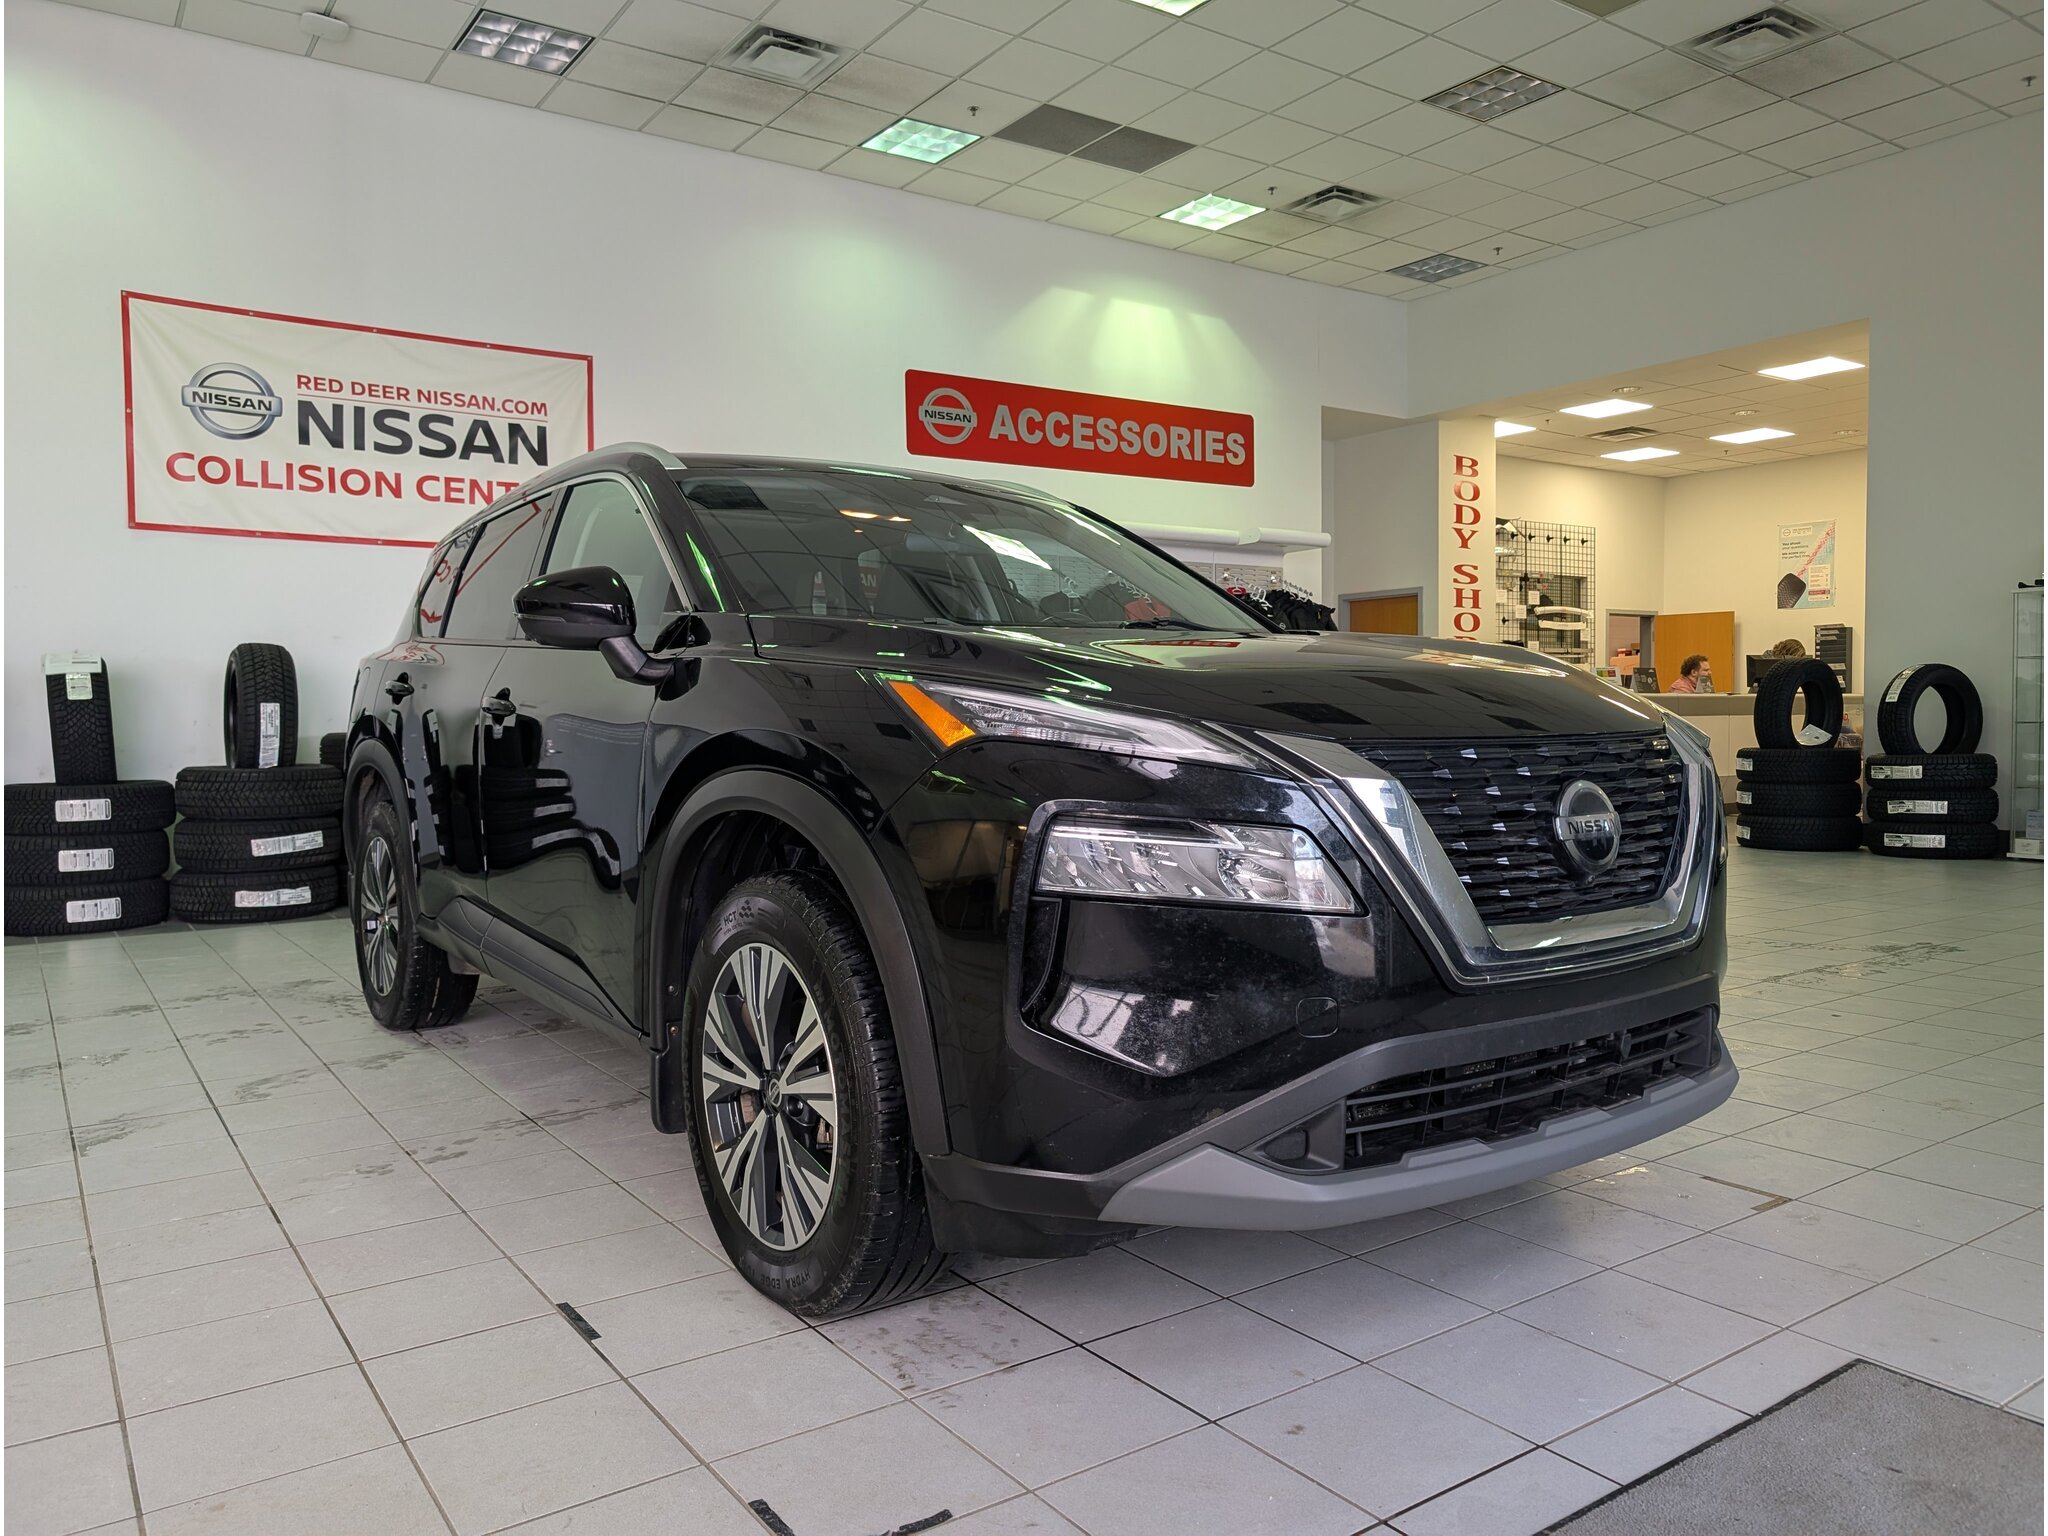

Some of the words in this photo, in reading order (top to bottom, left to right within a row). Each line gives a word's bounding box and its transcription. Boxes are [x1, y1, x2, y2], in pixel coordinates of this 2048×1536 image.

[192, 390, 272, 412] NISSAN
[296, 374, 344, 394] RED
[350, 380, 411, 402] DEER
[417, 388, 548, 417] NISSAN.COM
[924, 409, 972, 424] NISSAN
[297, 400, 549, 466] NISSAN
[989, 404, 1246, 466] ACCESSORIES
[165, 452, 403, 499] COLLISION
[415, 475, 520, 506] CENT
[1452, 454, 1481, 549] BODY
[1452, 563, 1482, 641] SHO
[760, 1273, 781, 1290] EDGE
[785, 1268, 811, 1289] HYDRA
